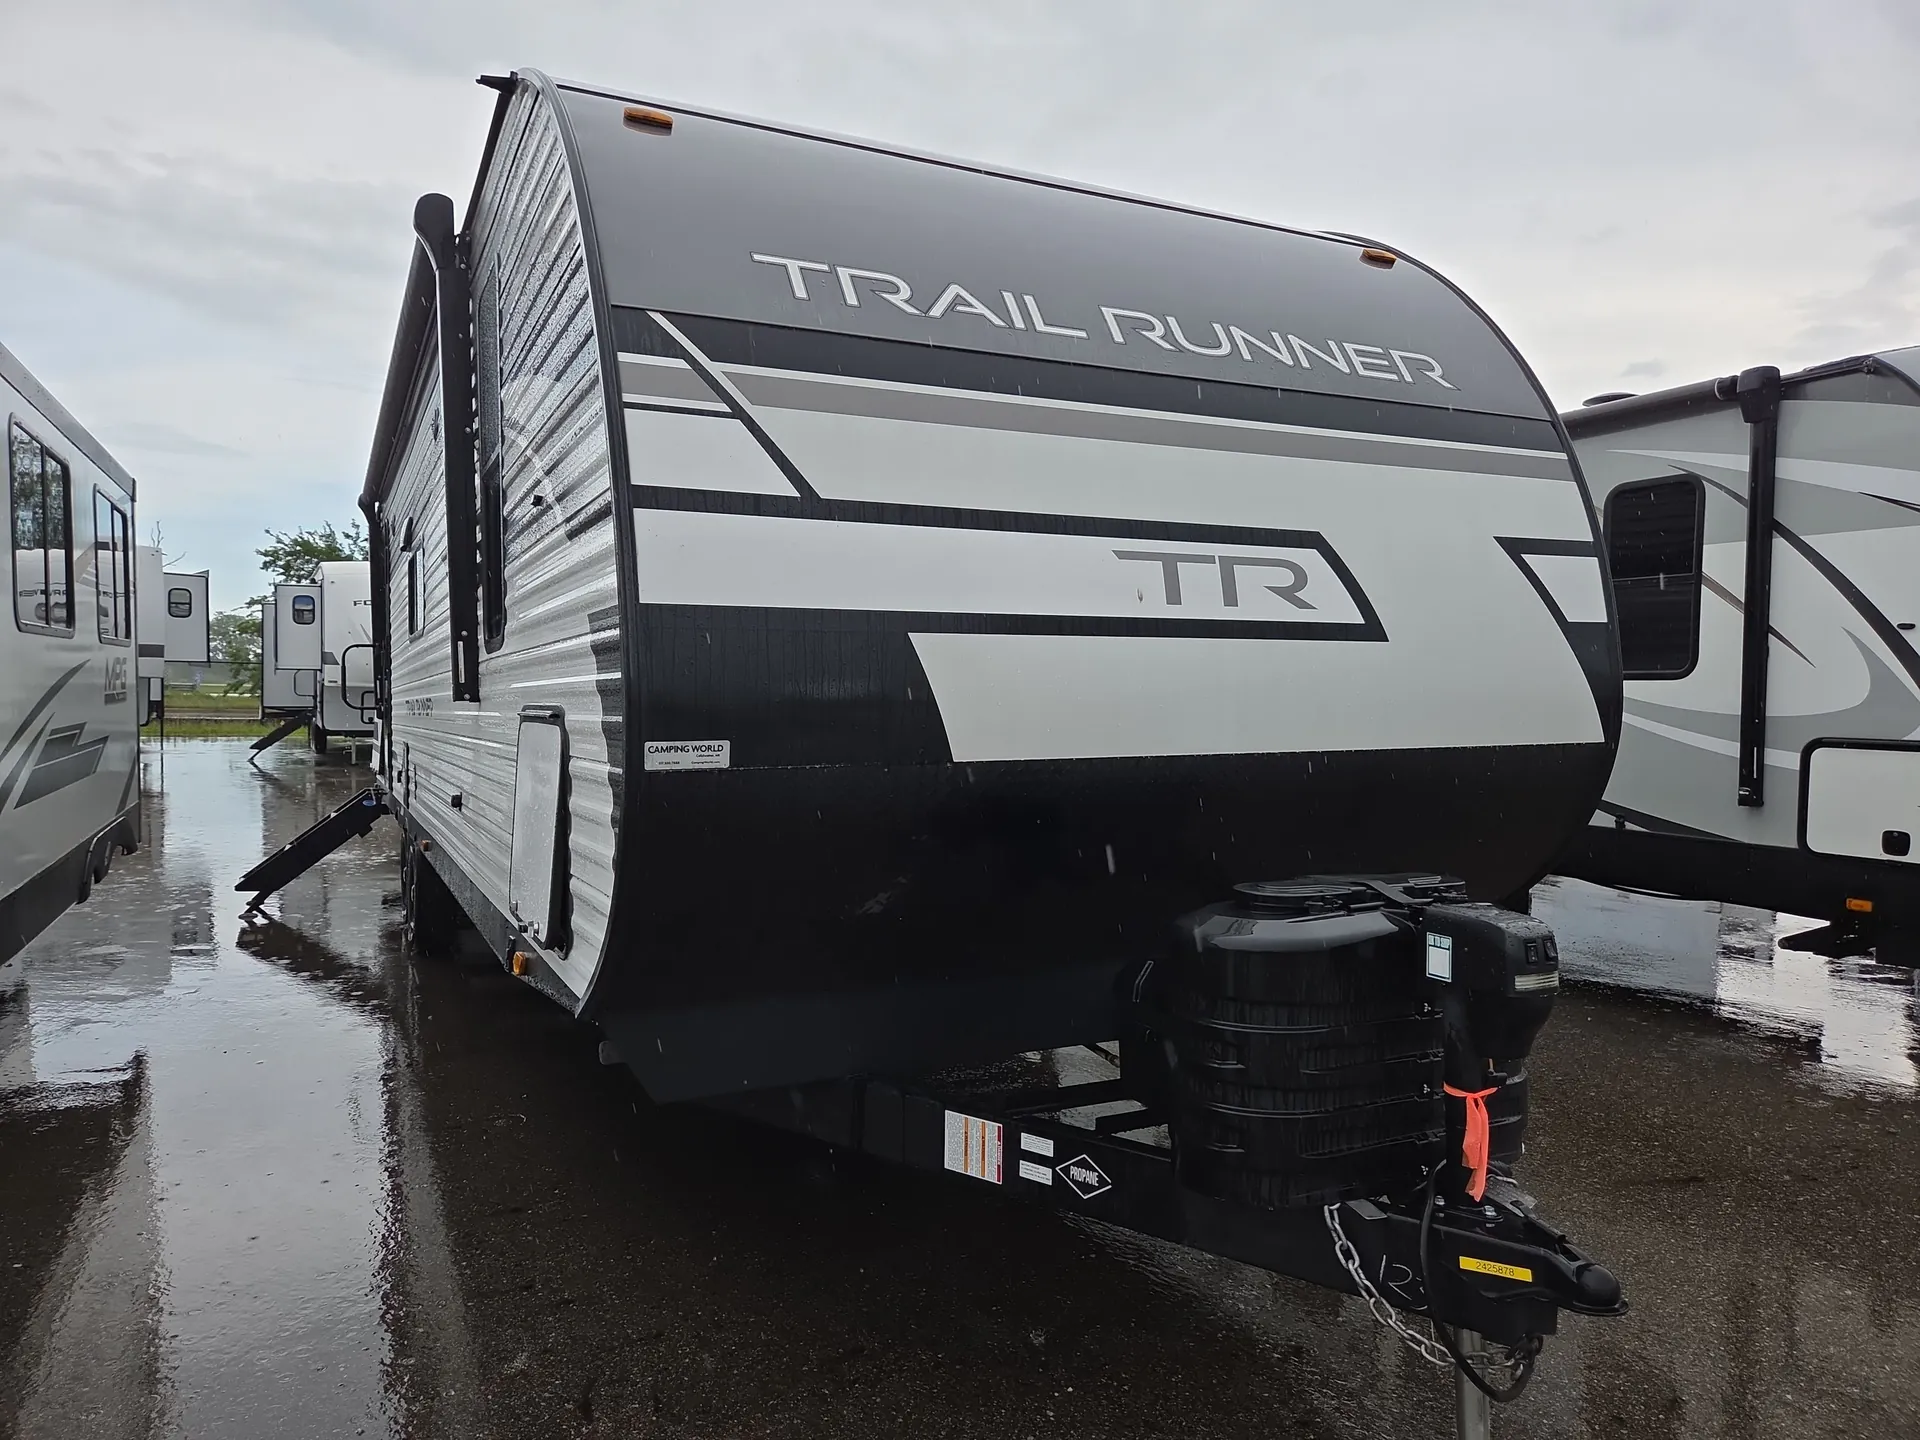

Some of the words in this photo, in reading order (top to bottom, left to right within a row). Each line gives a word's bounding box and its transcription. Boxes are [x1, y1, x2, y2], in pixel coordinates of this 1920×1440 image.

[750, 251, 1089, 339] TRAIL
[1098, 305, 1460, 391] RUNNER
[1111, 550, 1318, 610] TR
[104, 656, 127, 692] MPG
[648, 745, 690, 753] CAMPING
[691, 744, 724, 752] WORLD
[1069, 1165, 1099, 1186] PROPANE
[1475, 1261, 1515, 1276] 2425878
